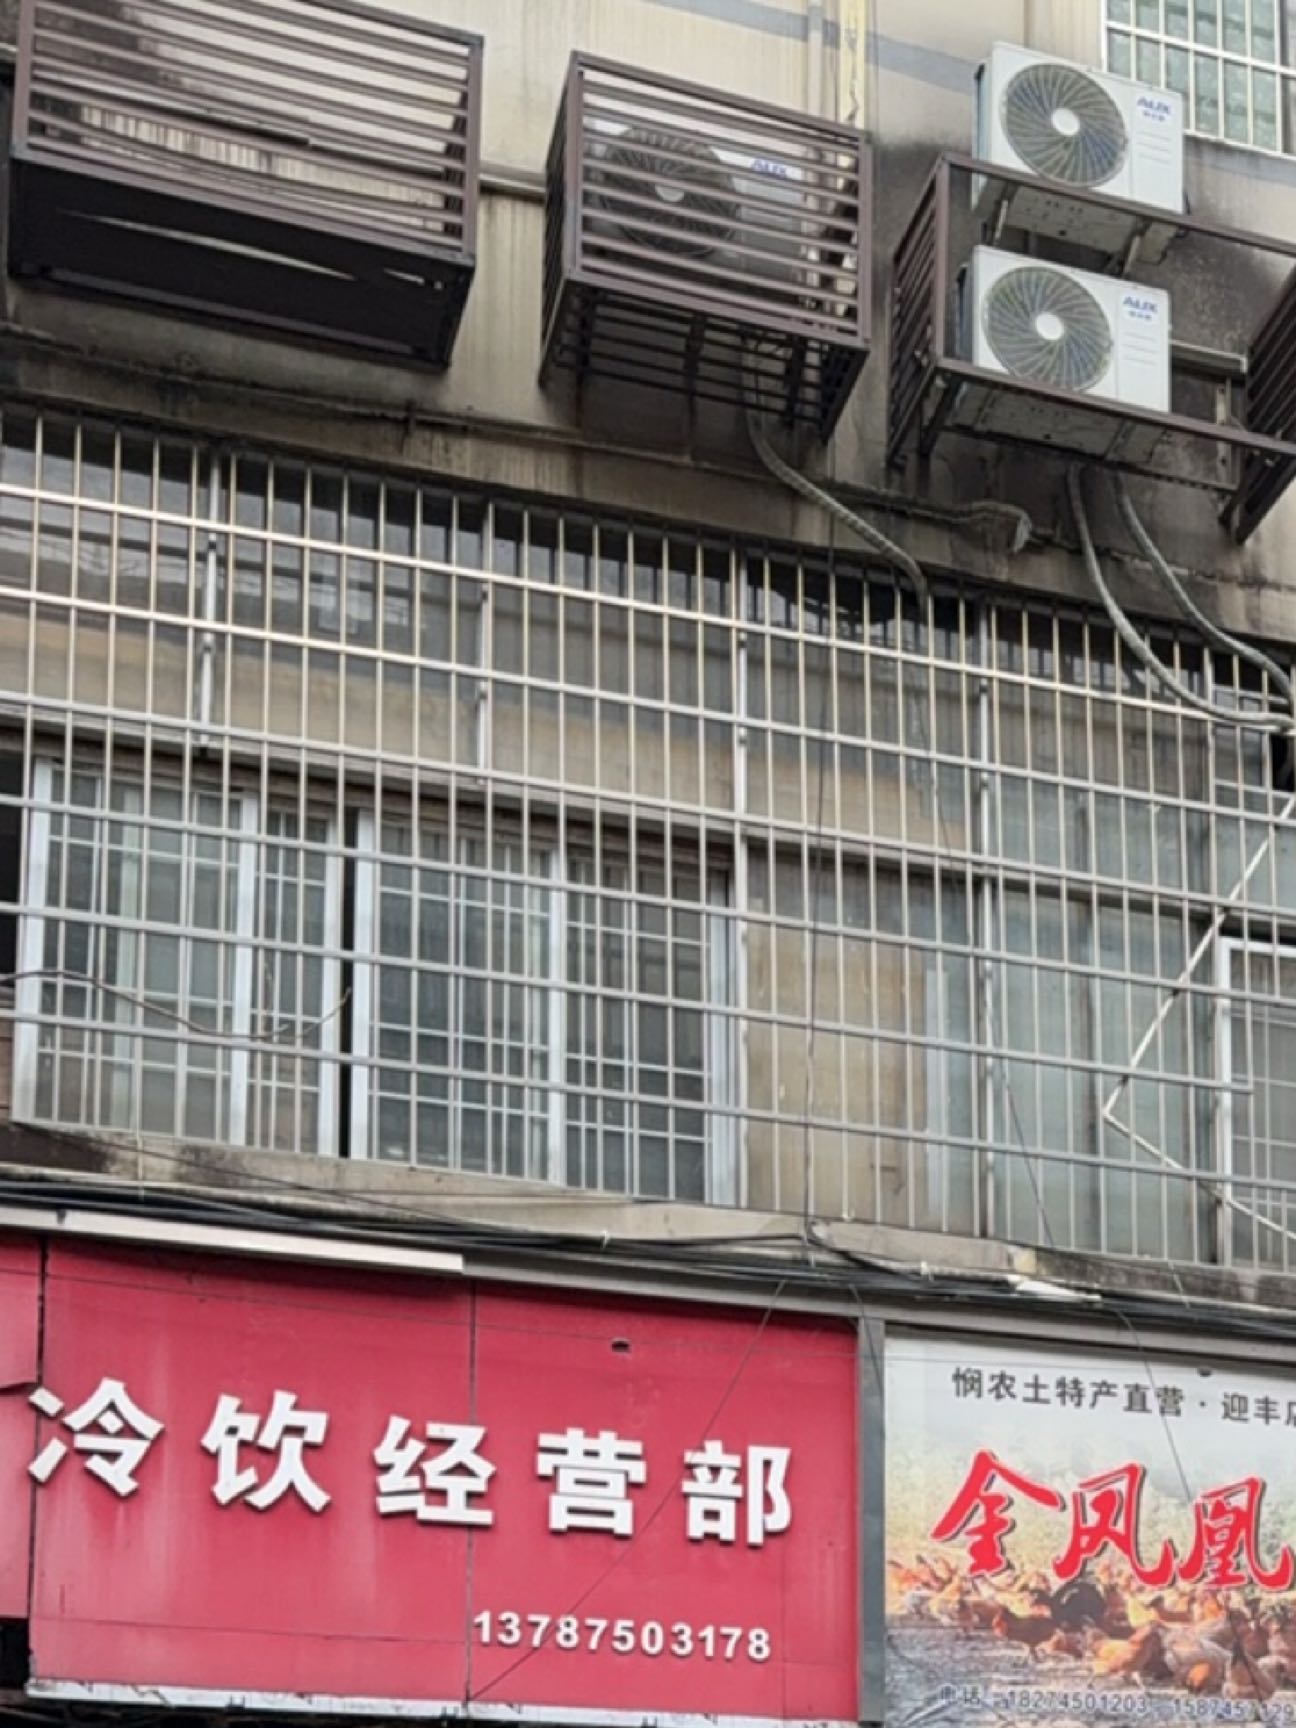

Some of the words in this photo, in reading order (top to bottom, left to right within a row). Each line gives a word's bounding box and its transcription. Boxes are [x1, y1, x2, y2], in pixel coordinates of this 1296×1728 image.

[27, 1376, 793, 1546] 冷饮经营部
[473, 1609, 773, 1662] 13787503178
